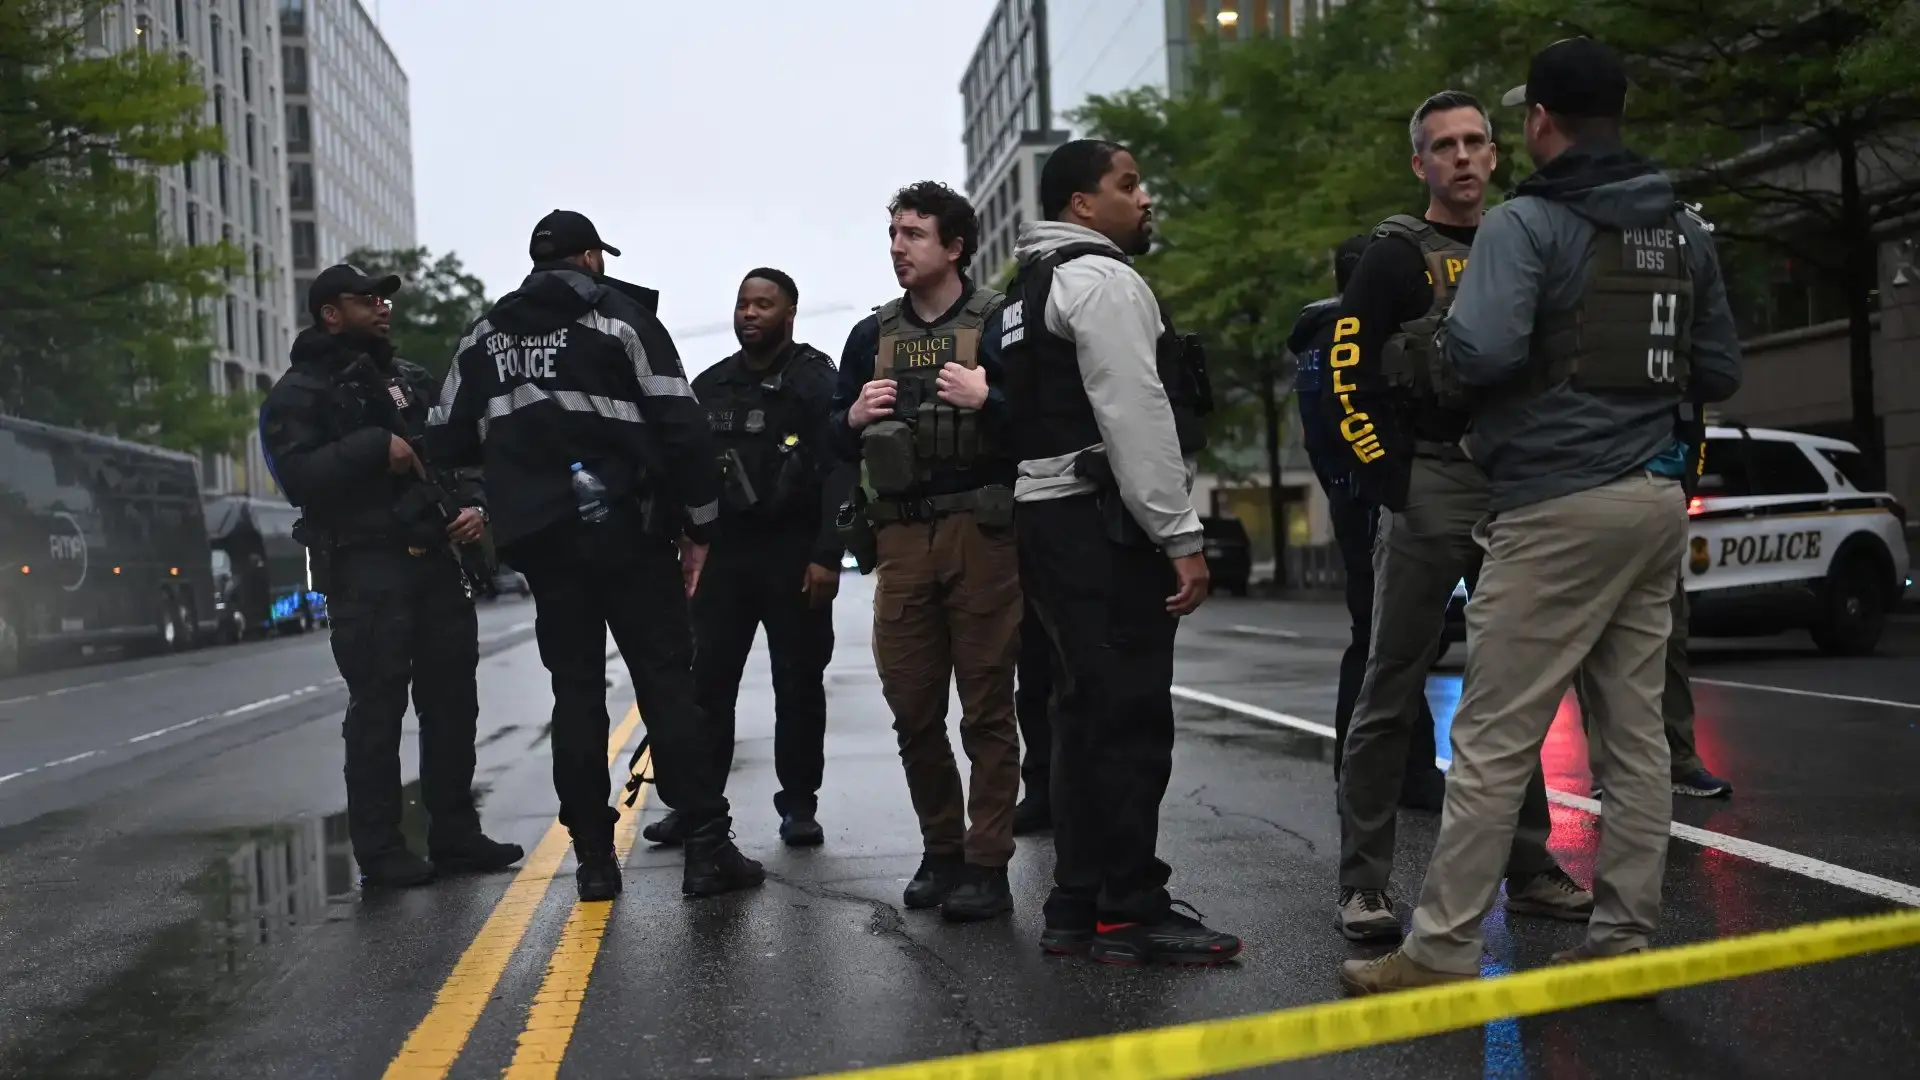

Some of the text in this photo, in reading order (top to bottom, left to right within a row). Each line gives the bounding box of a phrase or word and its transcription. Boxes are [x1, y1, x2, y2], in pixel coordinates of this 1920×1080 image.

[1623, 228, 1675, 249] POLICE
[1636, 249, 1665, 270] DSS
[486, 331, 518, 356] SECRT
[896, 337, 951, 355] POLICE
[495, 347, 557, 383] POLICE
[909, 352, 937, 368] HSI
[1330, 316, 1385, 463] POLICE
[1717, 530, 1821, 567] POLICE
